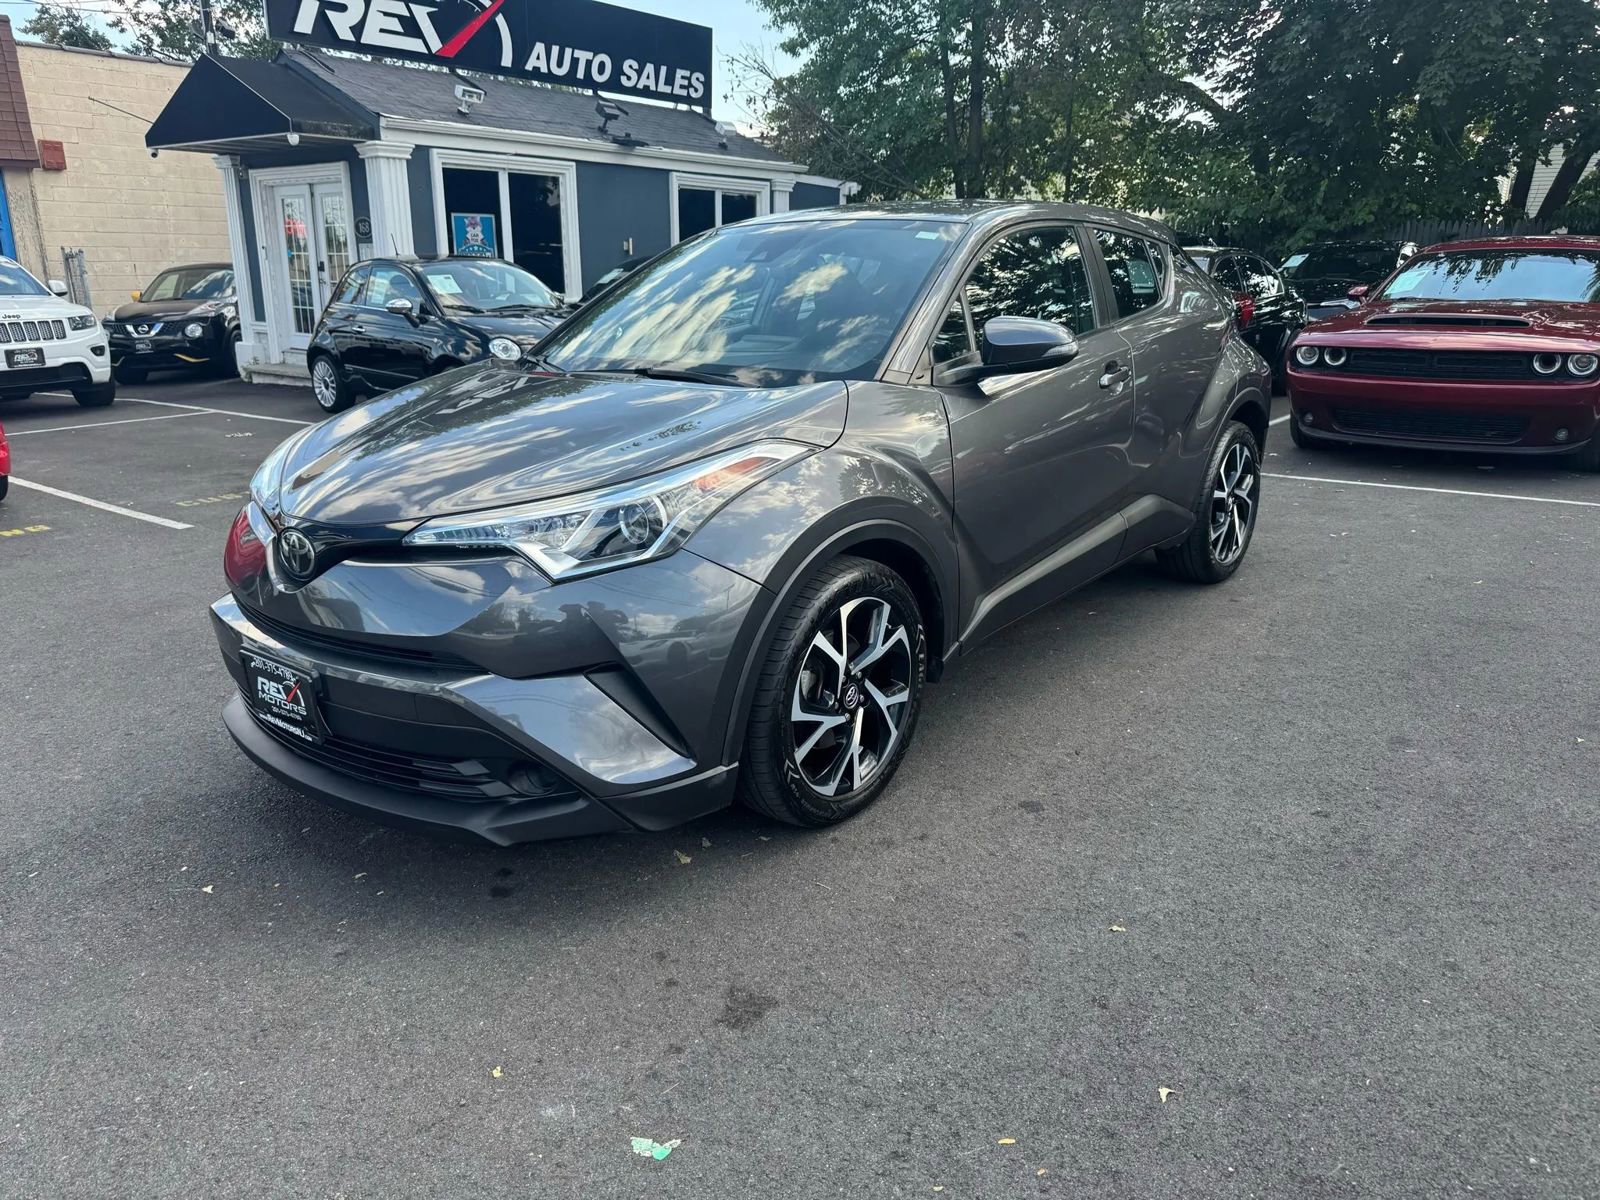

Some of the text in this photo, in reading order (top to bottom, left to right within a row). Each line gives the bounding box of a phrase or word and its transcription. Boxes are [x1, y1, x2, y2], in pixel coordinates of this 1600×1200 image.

[525, 42, 705, 98] AUTO SALES
[257, 676, 302, 703] REV
[258, 690, 307, 715] MOTORS
